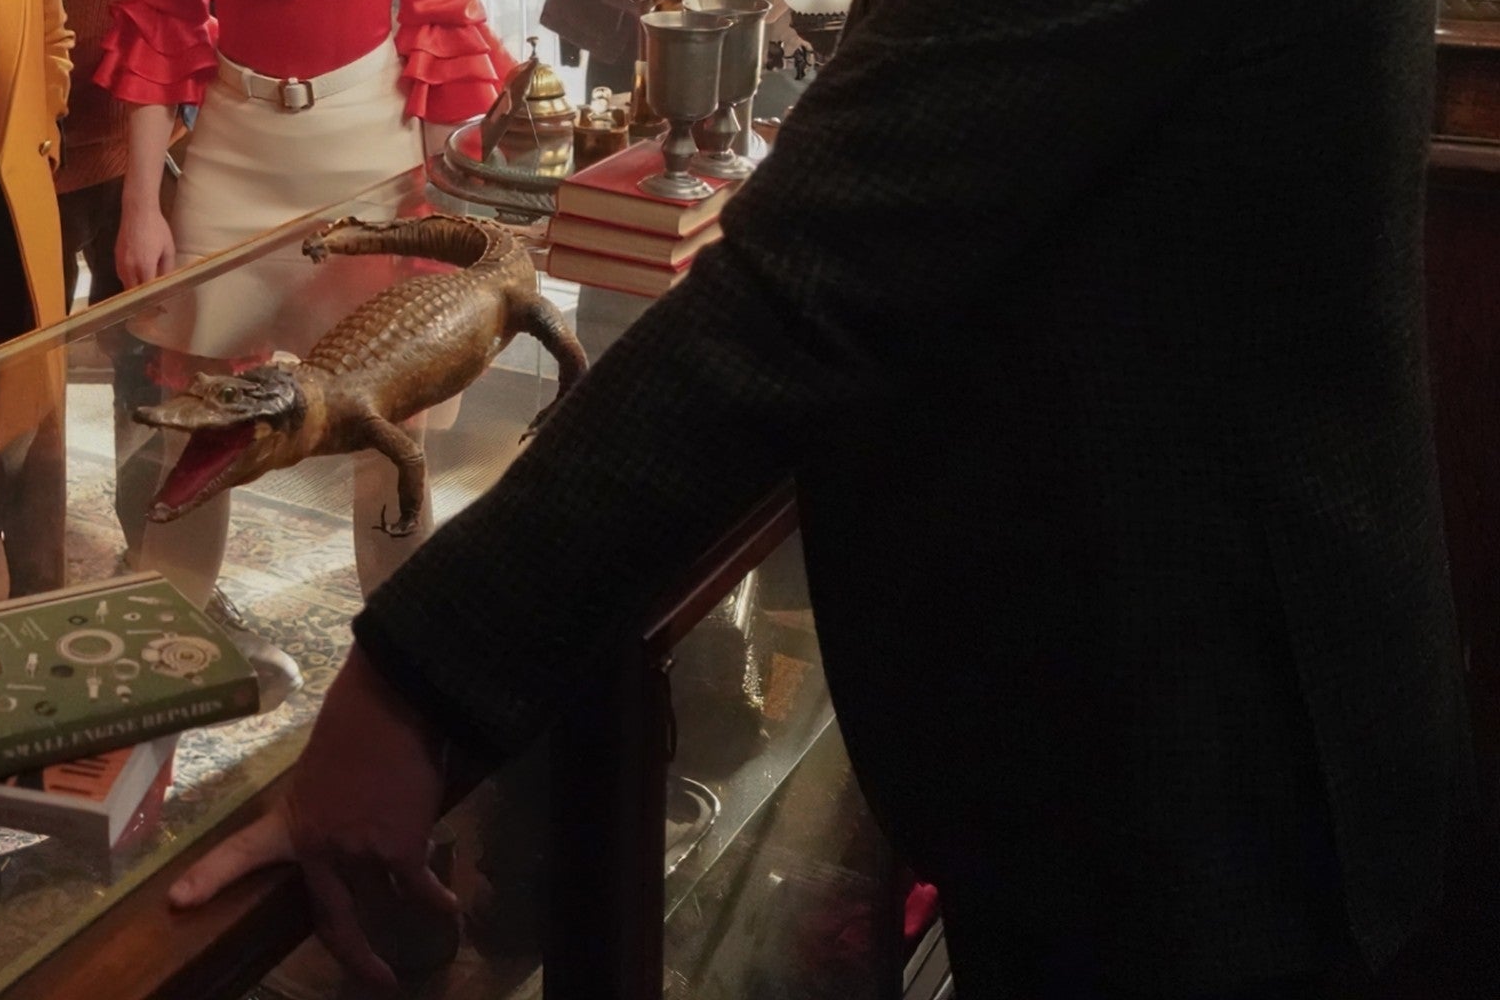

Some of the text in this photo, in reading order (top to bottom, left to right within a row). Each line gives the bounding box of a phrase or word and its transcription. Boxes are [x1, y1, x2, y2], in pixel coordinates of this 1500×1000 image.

[3, 699, 223, 758] SMALL ENGINE REPAIRS
